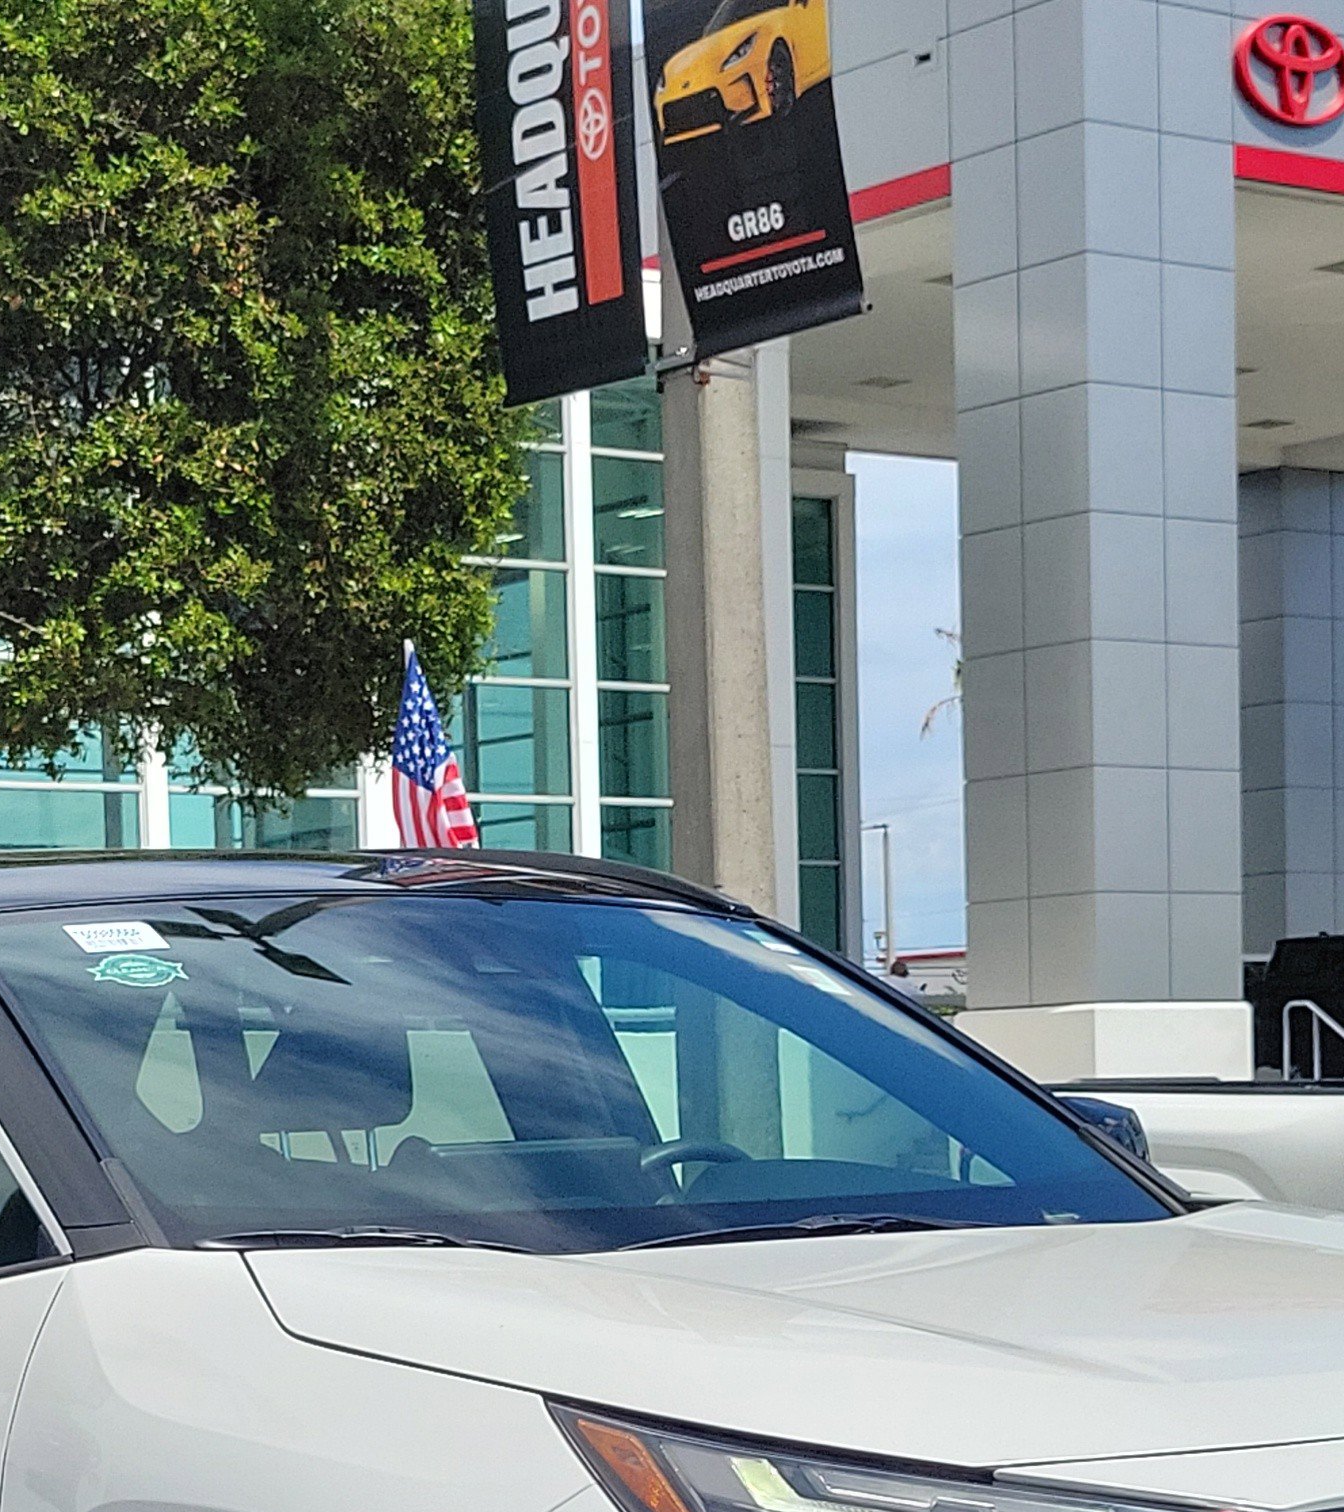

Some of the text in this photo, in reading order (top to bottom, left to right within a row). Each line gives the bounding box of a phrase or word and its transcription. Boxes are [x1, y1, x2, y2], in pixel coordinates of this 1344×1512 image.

[576, 0, 603, 87] TO
[727, 202, 785, 242] GR86
[694, 247, 845, 303] HEADQUARTERTOYOTA.COM
